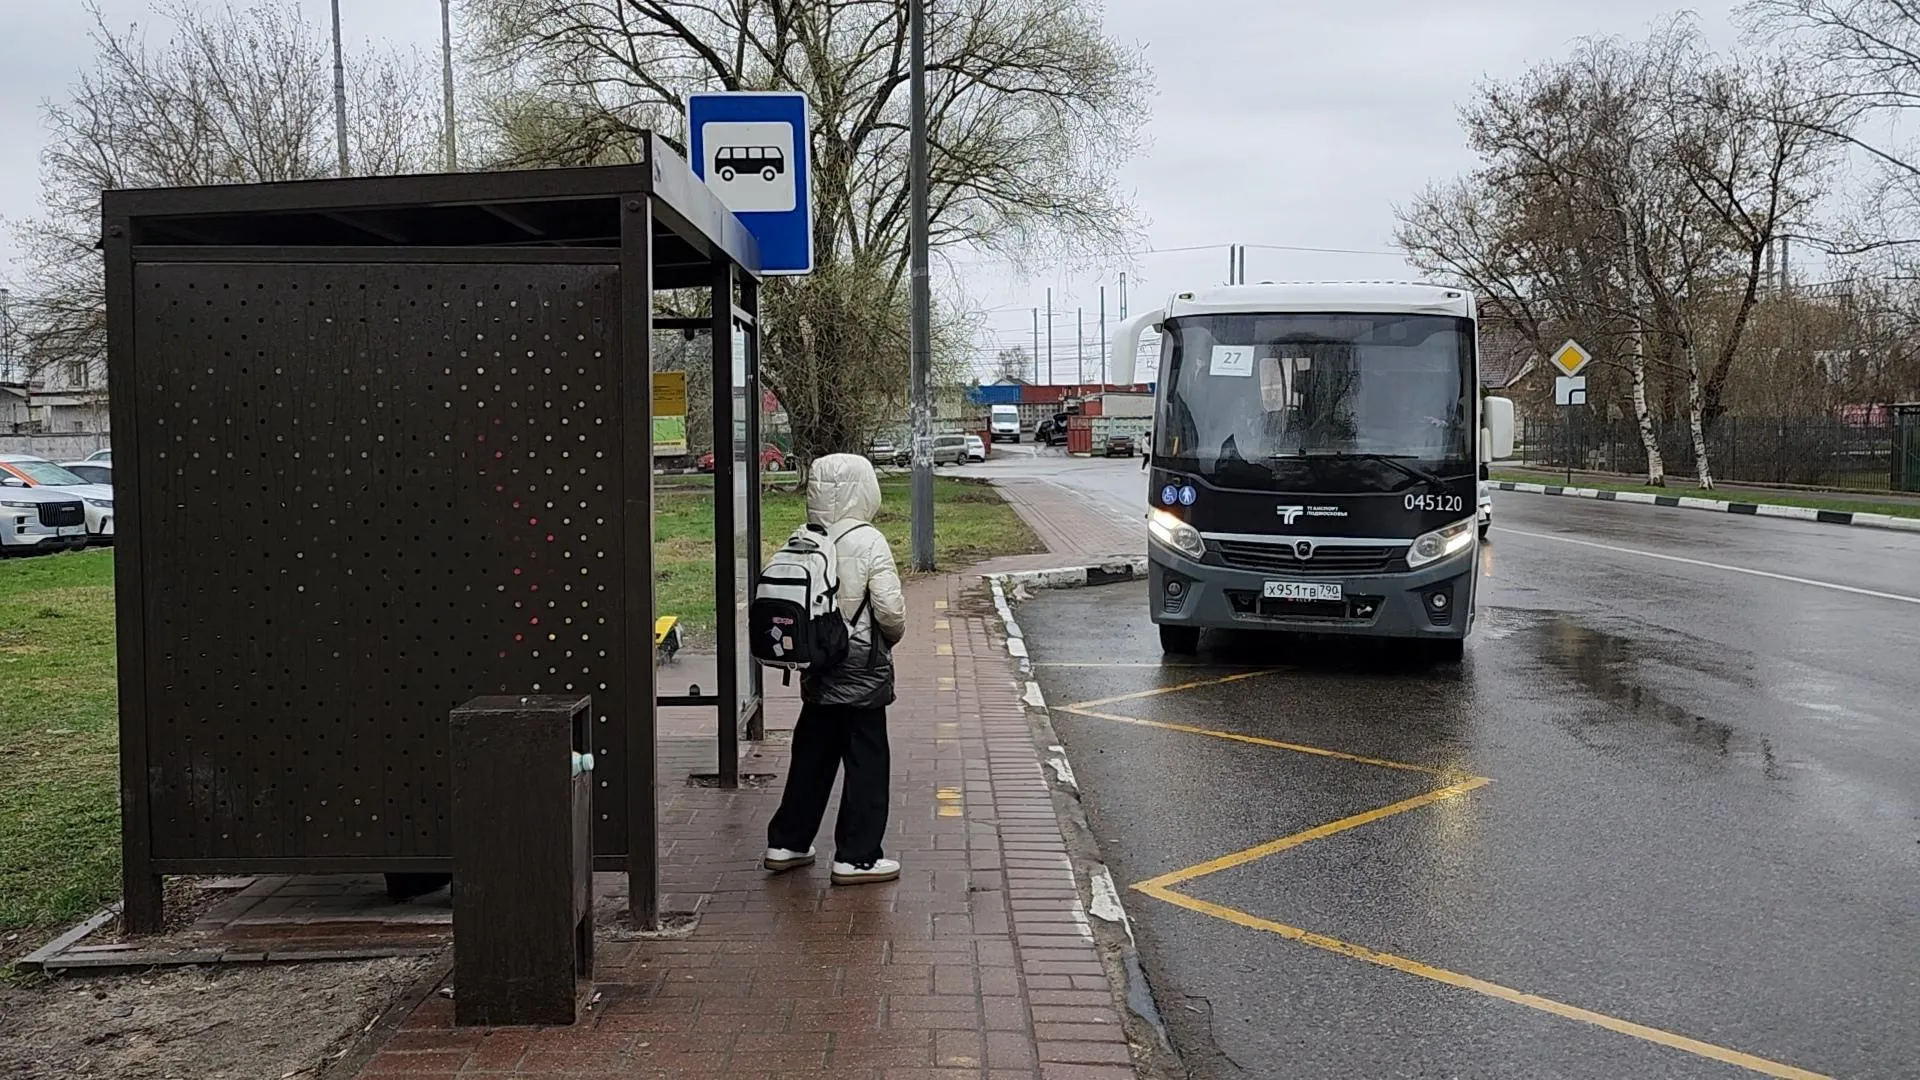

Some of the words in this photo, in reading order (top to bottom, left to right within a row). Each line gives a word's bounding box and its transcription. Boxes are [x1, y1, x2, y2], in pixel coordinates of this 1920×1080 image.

[1223, 351, 1242, 364] 27
[1404, 494, 1463, 511] 045120
[1320, 585, 1339, 595] 790
